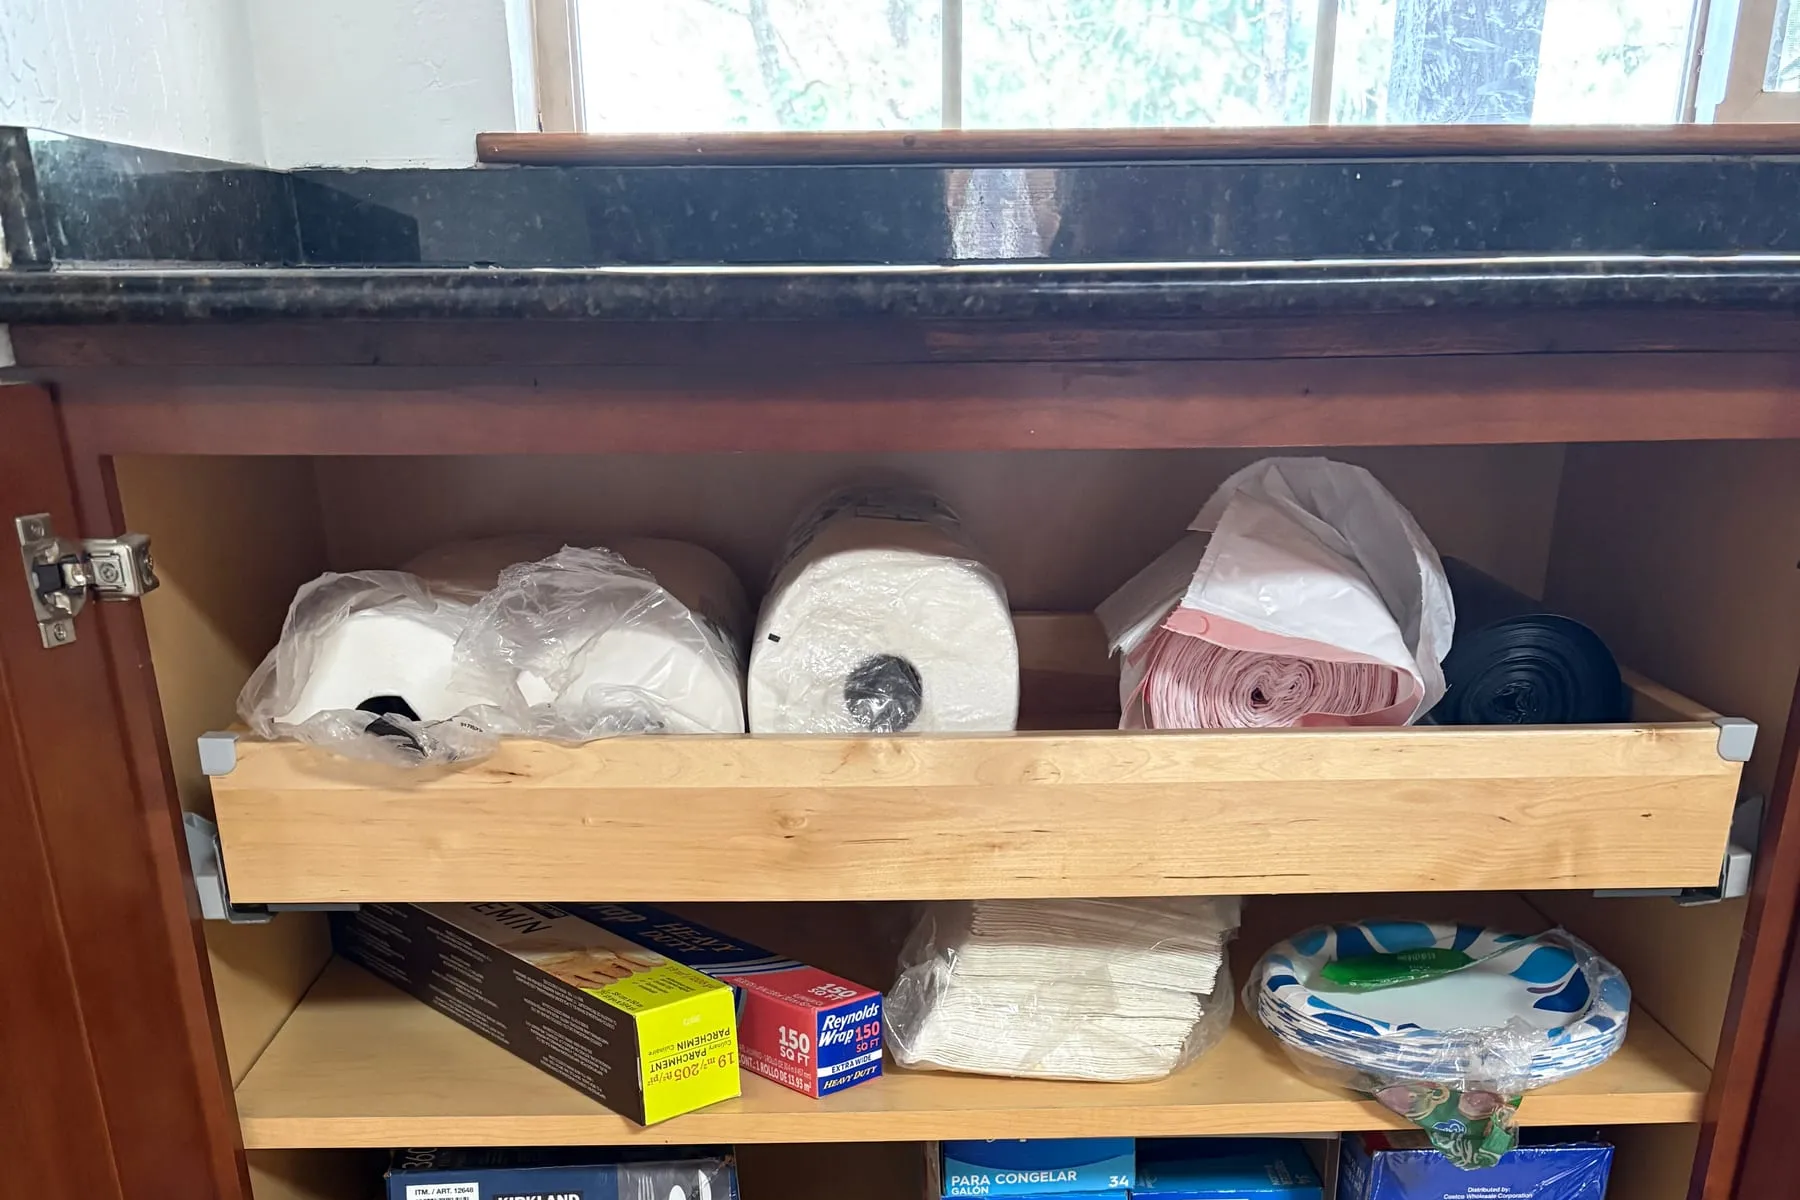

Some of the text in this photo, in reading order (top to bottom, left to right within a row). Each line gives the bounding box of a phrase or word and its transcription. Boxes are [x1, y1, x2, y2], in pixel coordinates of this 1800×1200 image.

[817, 983, 857, 998] 150
[822, 1003, 880, 1031] Reynolds
[677, 1027, 730, 1051] PARCHEMIN
[778, 1026, 810, 1053] 150
[819, 1029, 854, 1047] Wrap
[855, 1021, 880, 1042] 150
[856, 1038, 880, 1053] SQ FT
[650, 1039, 731, 1073] Culinary PARCHMENT
[718, 1052, 735, 1068] 19
[780, 1046, 795, 1060] SQ
[797, 1053, 810, 1067] FT
[831, 1054, 872, 1073] EXTRA WIDE
[823, 1066, 877, 1089] HEAVY DUTY
[951, 1174, 990, 1186] PARA
[995, 1171, 1077, 1184] CONGELAR
[1109, 1175, 1129, 1188] 34
[951, 1185, 989, 1195] GALÓN
